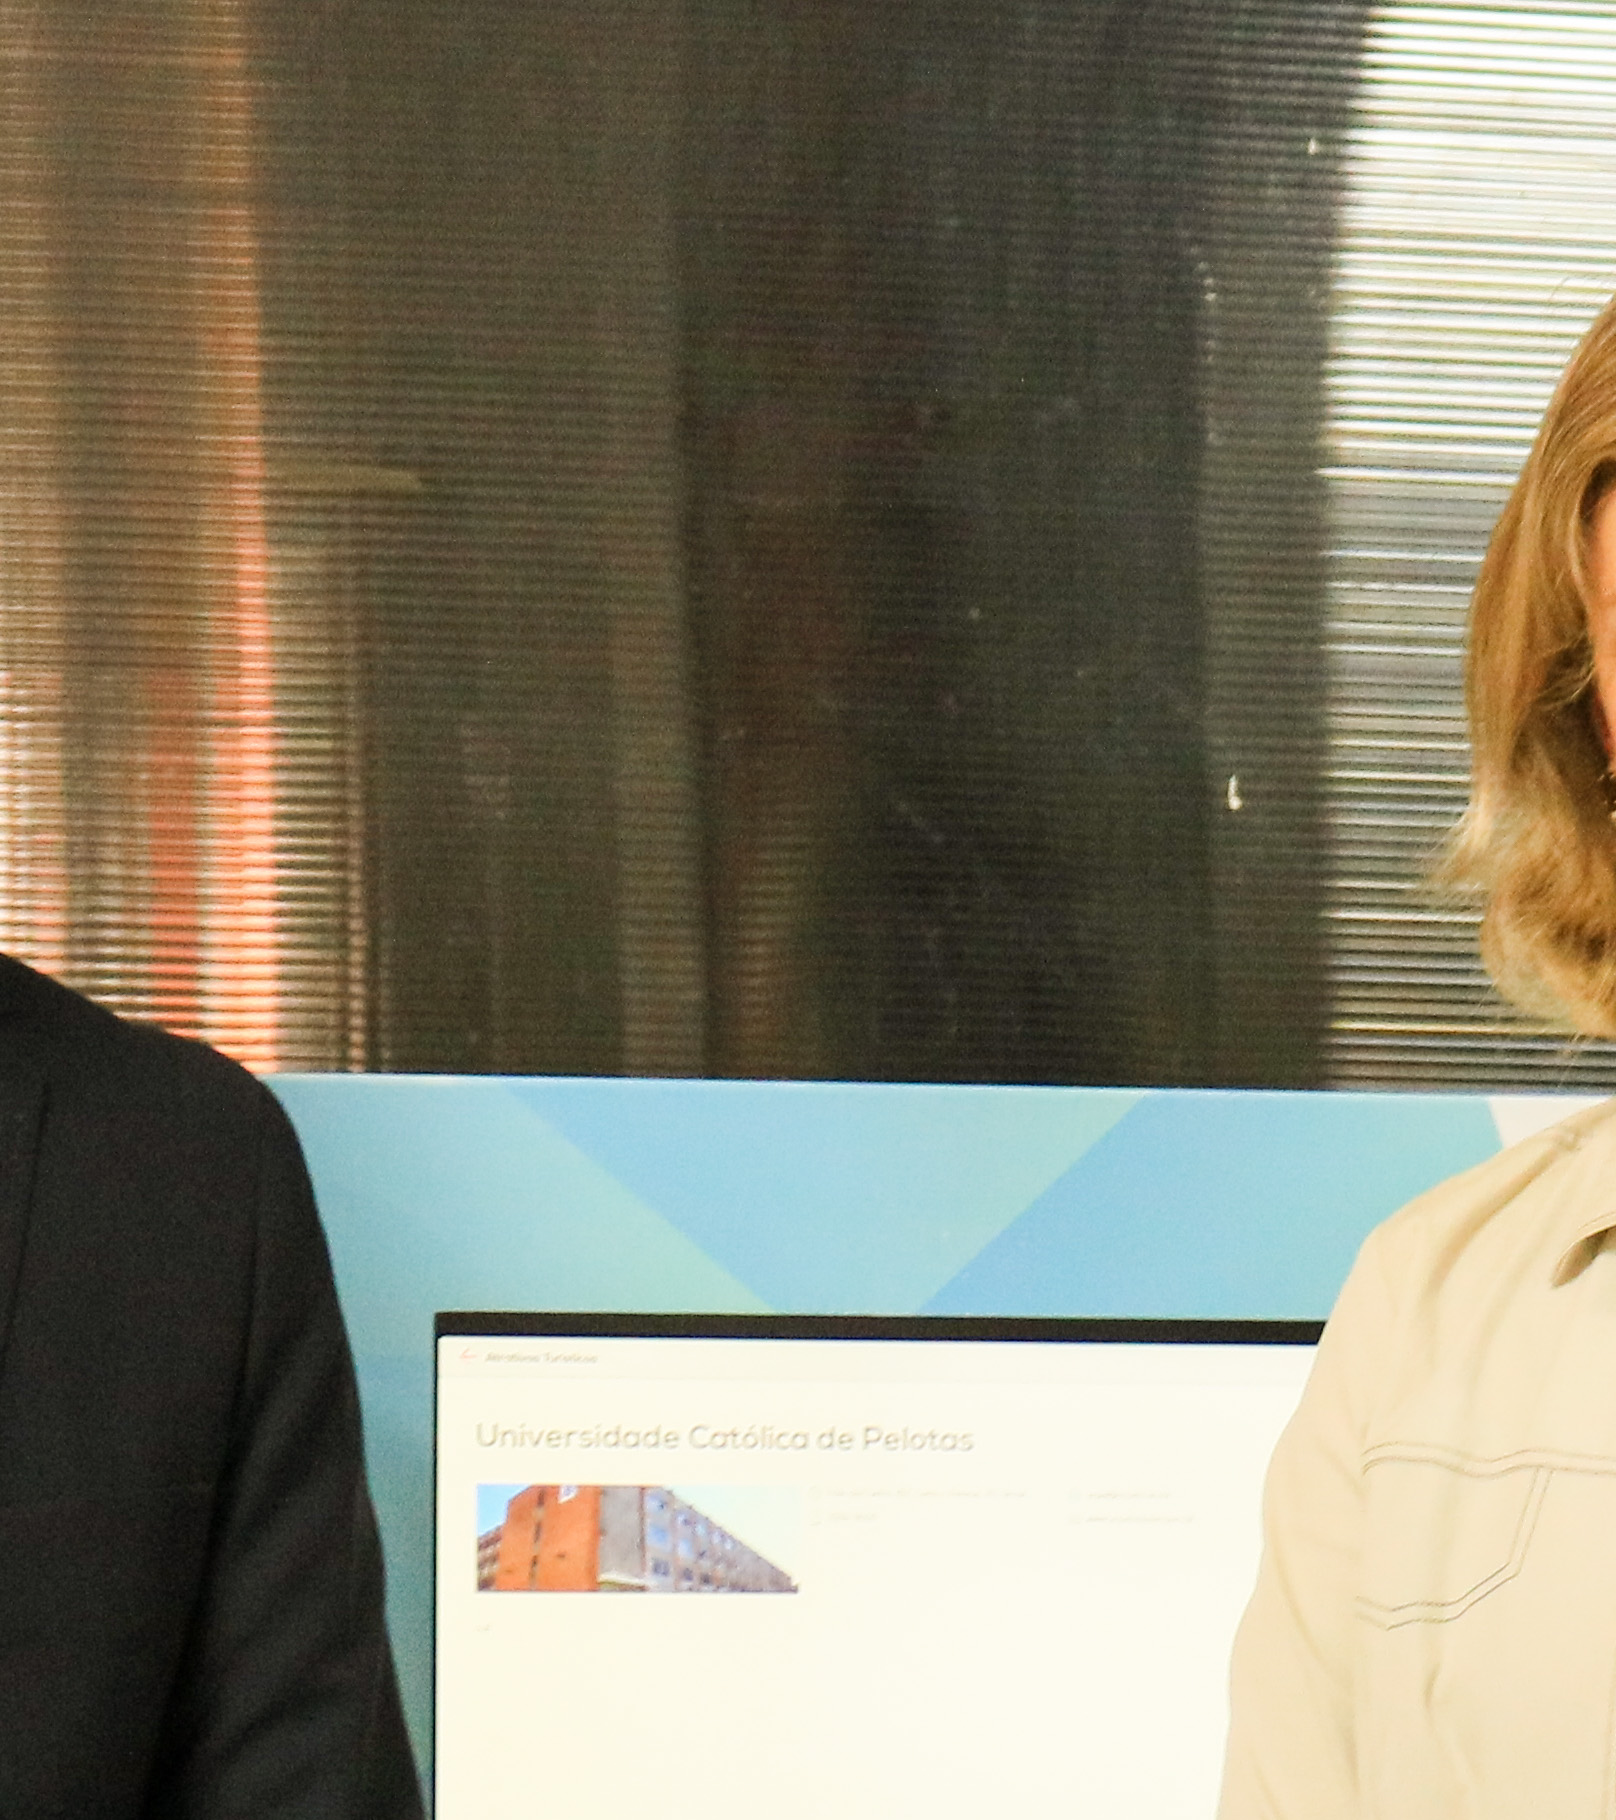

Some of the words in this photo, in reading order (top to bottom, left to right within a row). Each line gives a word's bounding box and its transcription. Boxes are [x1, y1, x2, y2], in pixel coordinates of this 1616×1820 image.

[475, 1421, 681, 1450] Universidade
[687, 1423, 809, 1451] Católica
[817, 1425, 854, 1451] de
[862, 1425, 976, 1452] Pelotas
